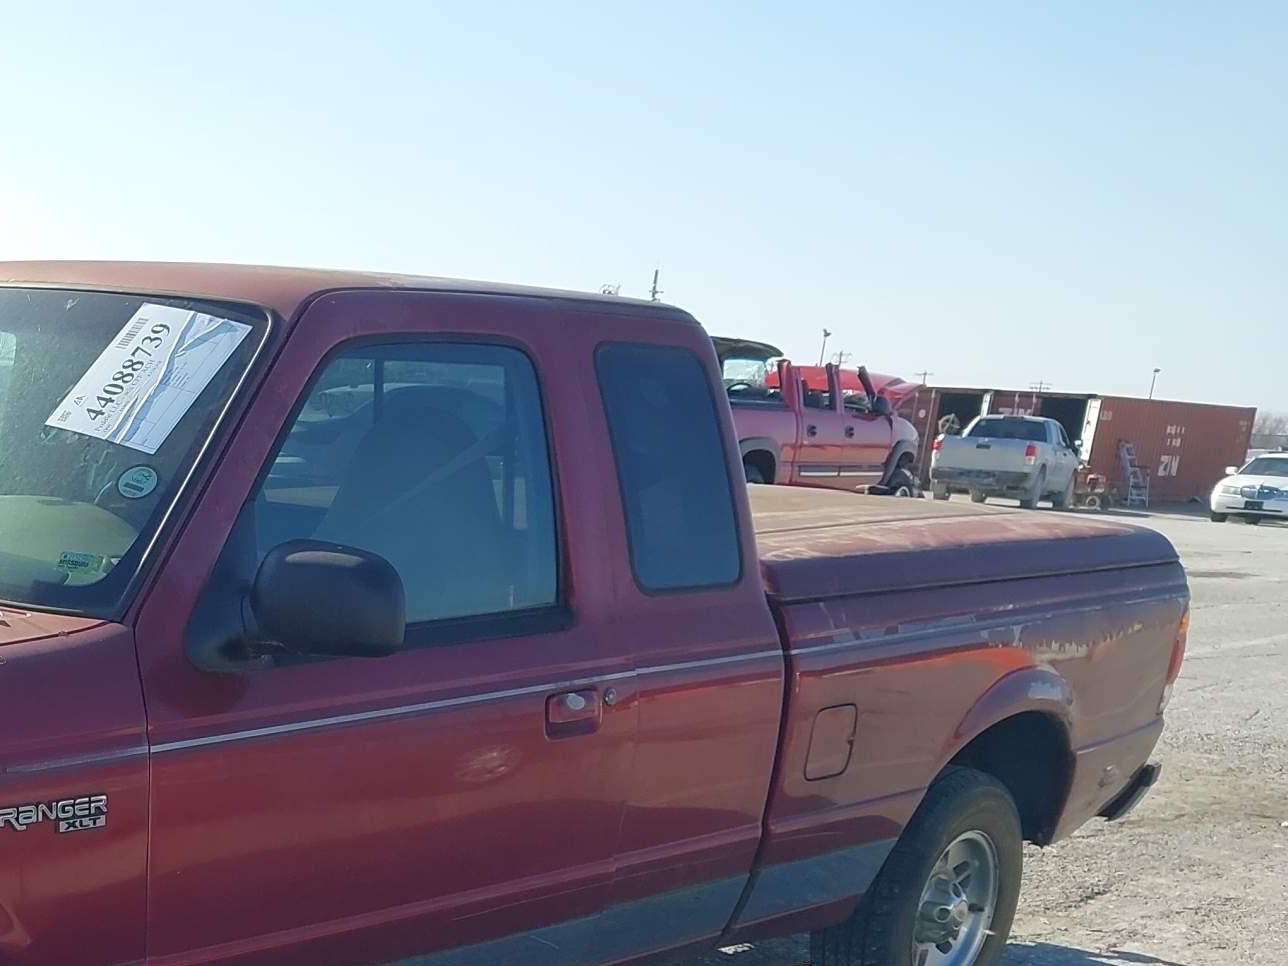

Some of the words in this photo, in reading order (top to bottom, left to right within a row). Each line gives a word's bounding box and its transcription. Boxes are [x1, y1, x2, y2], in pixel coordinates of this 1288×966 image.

[86, 322, 171, 423] 44088739
[0, 795, 108, 831] RANGER
[63, 816, 103, 831] XLT
